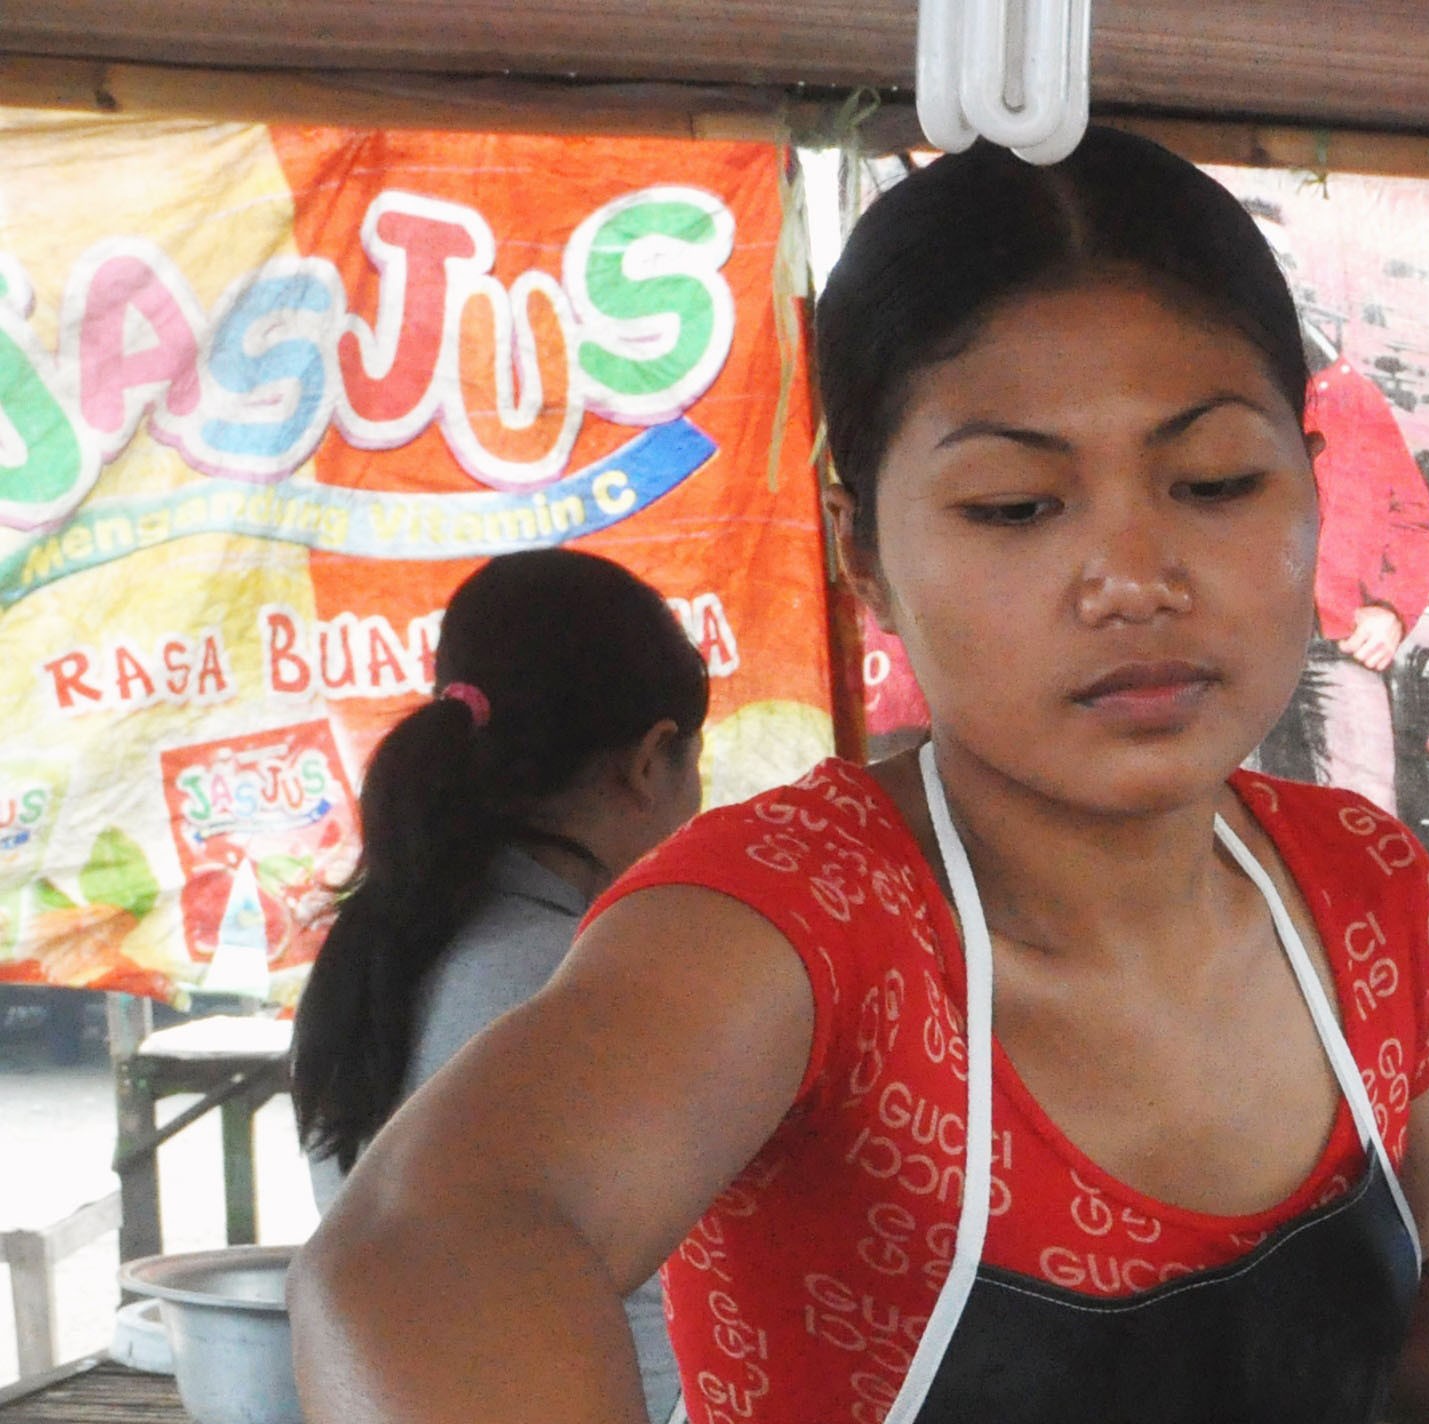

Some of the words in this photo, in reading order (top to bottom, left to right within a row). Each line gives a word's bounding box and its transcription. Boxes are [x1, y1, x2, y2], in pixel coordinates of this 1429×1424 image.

[368, 492, 586, 544] Vitamin
[589, 469, 637, 531] C
[44, 634, 229, 708] RASA
[180, 757, 327, 822] JASJUS
